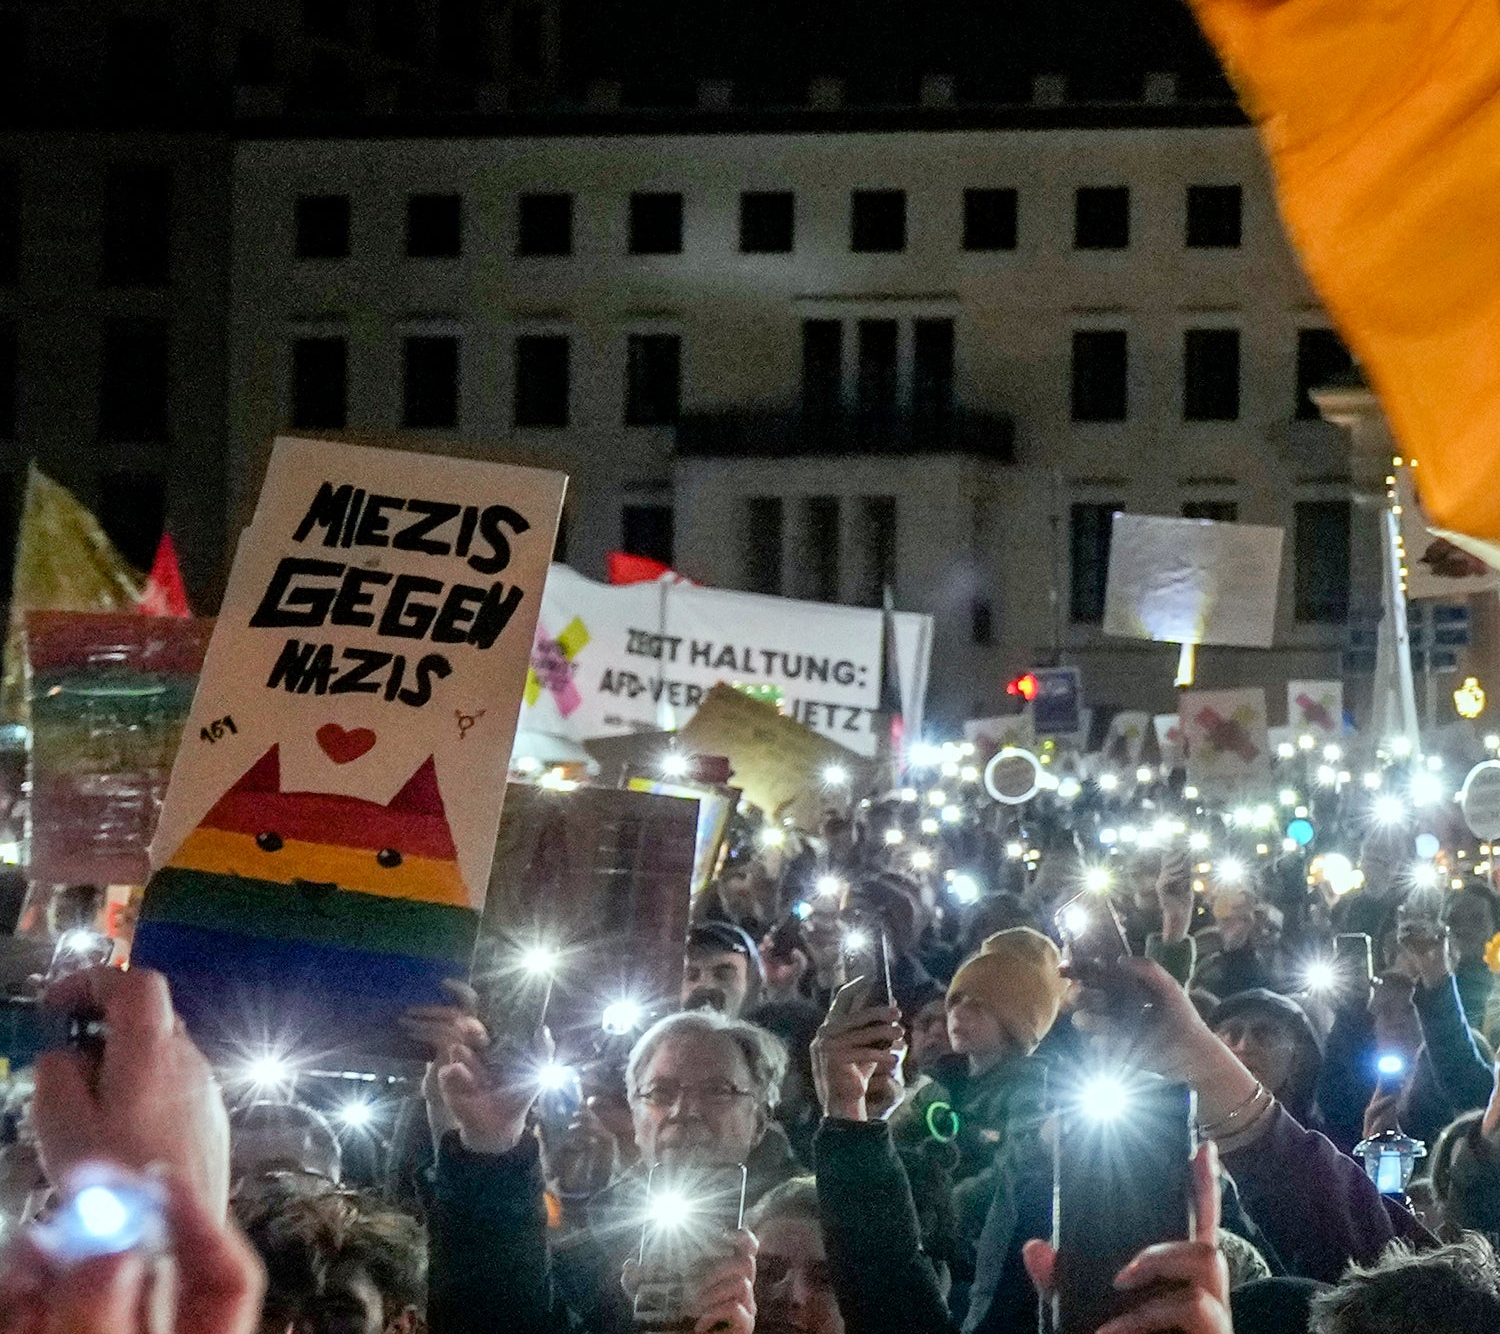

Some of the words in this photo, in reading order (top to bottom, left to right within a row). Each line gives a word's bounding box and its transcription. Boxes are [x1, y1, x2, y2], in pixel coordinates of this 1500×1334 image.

[292, 480, 531, 575] MIEZIS
[249, 556, 525, 650] GEGEN
[265, 637, 453, 708] NAZIS
[600, 666, 701, 708] AFD-VER
[690, 638, 867, 688] HALTUNG:
